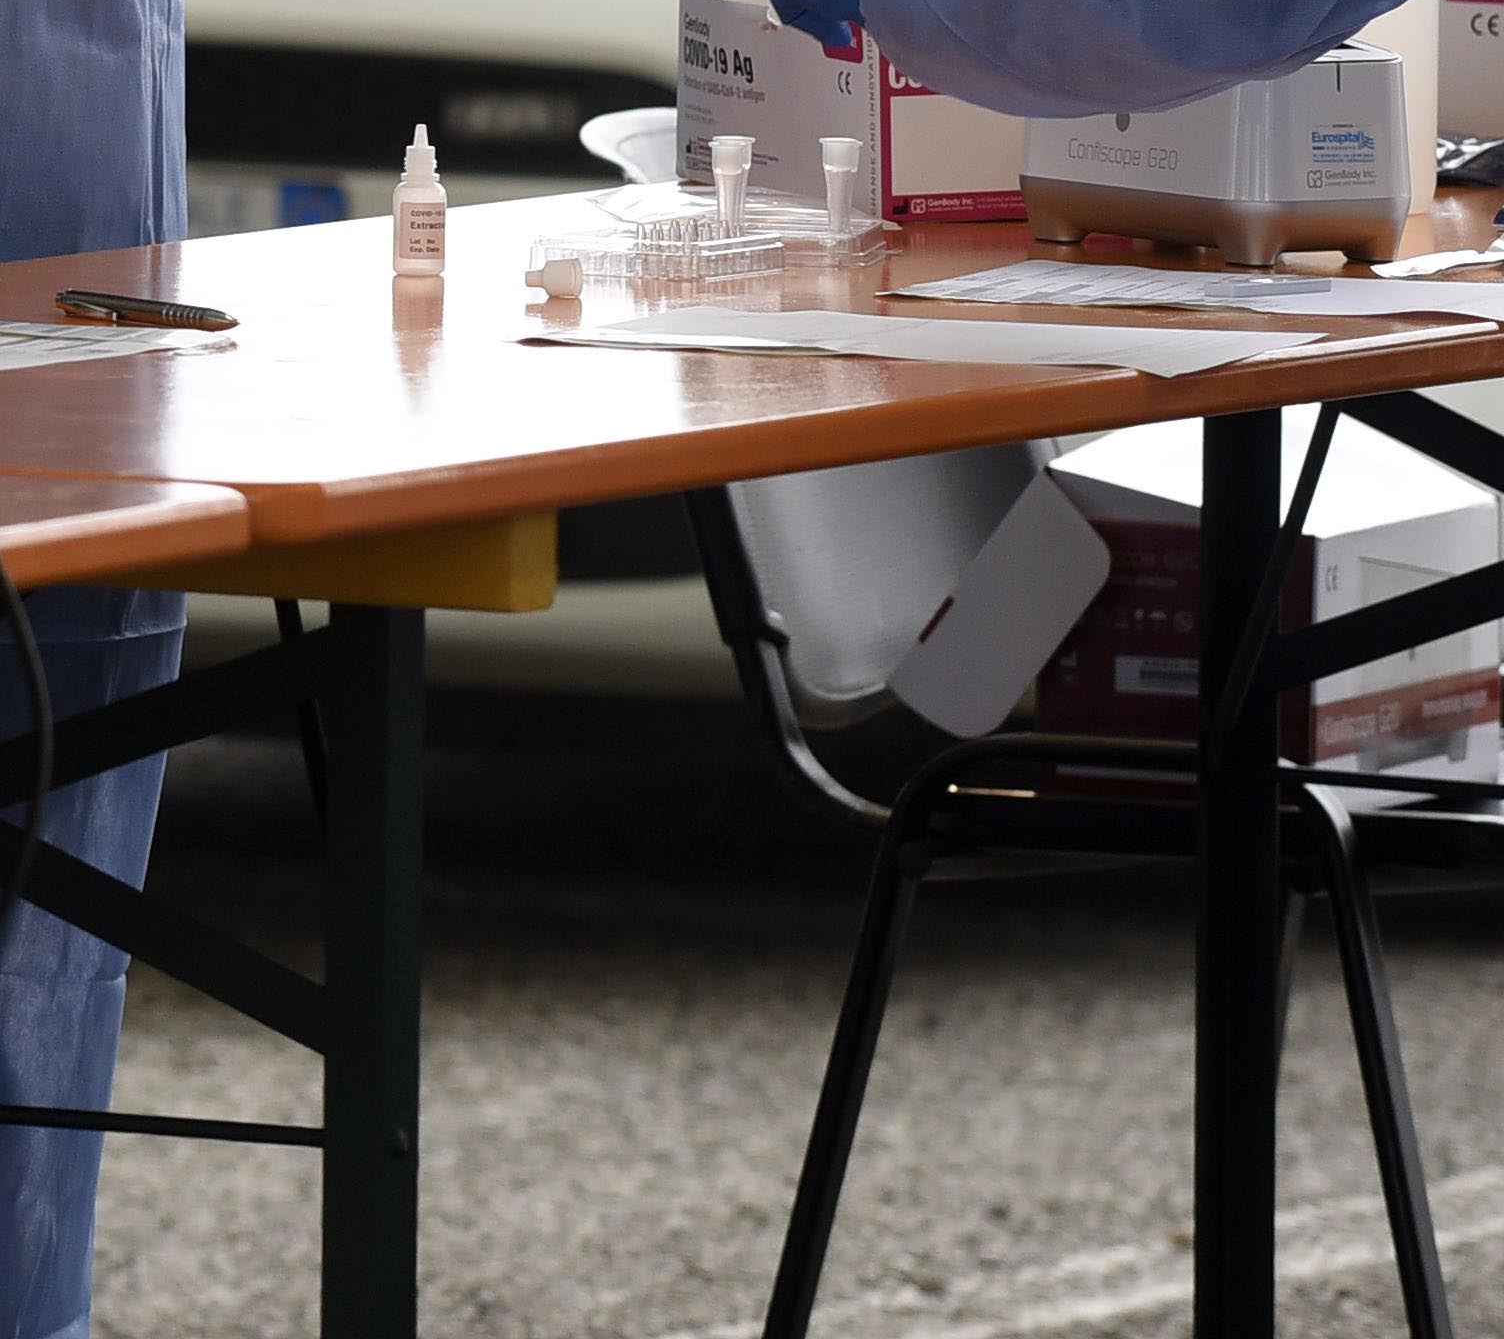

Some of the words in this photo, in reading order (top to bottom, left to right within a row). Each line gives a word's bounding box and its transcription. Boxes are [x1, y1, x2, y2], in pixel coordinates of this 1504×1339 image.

[683, 36, 728, 74] COVID-19
[733, 49, 754, 83] Ag
[866, 34, 875, 118] INNOVATIO
[1311, 129, 1361, 145] Eurospital
[1067, 137, 1142, 169] Confiscope
[1147, 147, 1179, 171] G20
[1325, 169, 1362, 181] GenBody
[927, 197, 961, 209] GenBody
